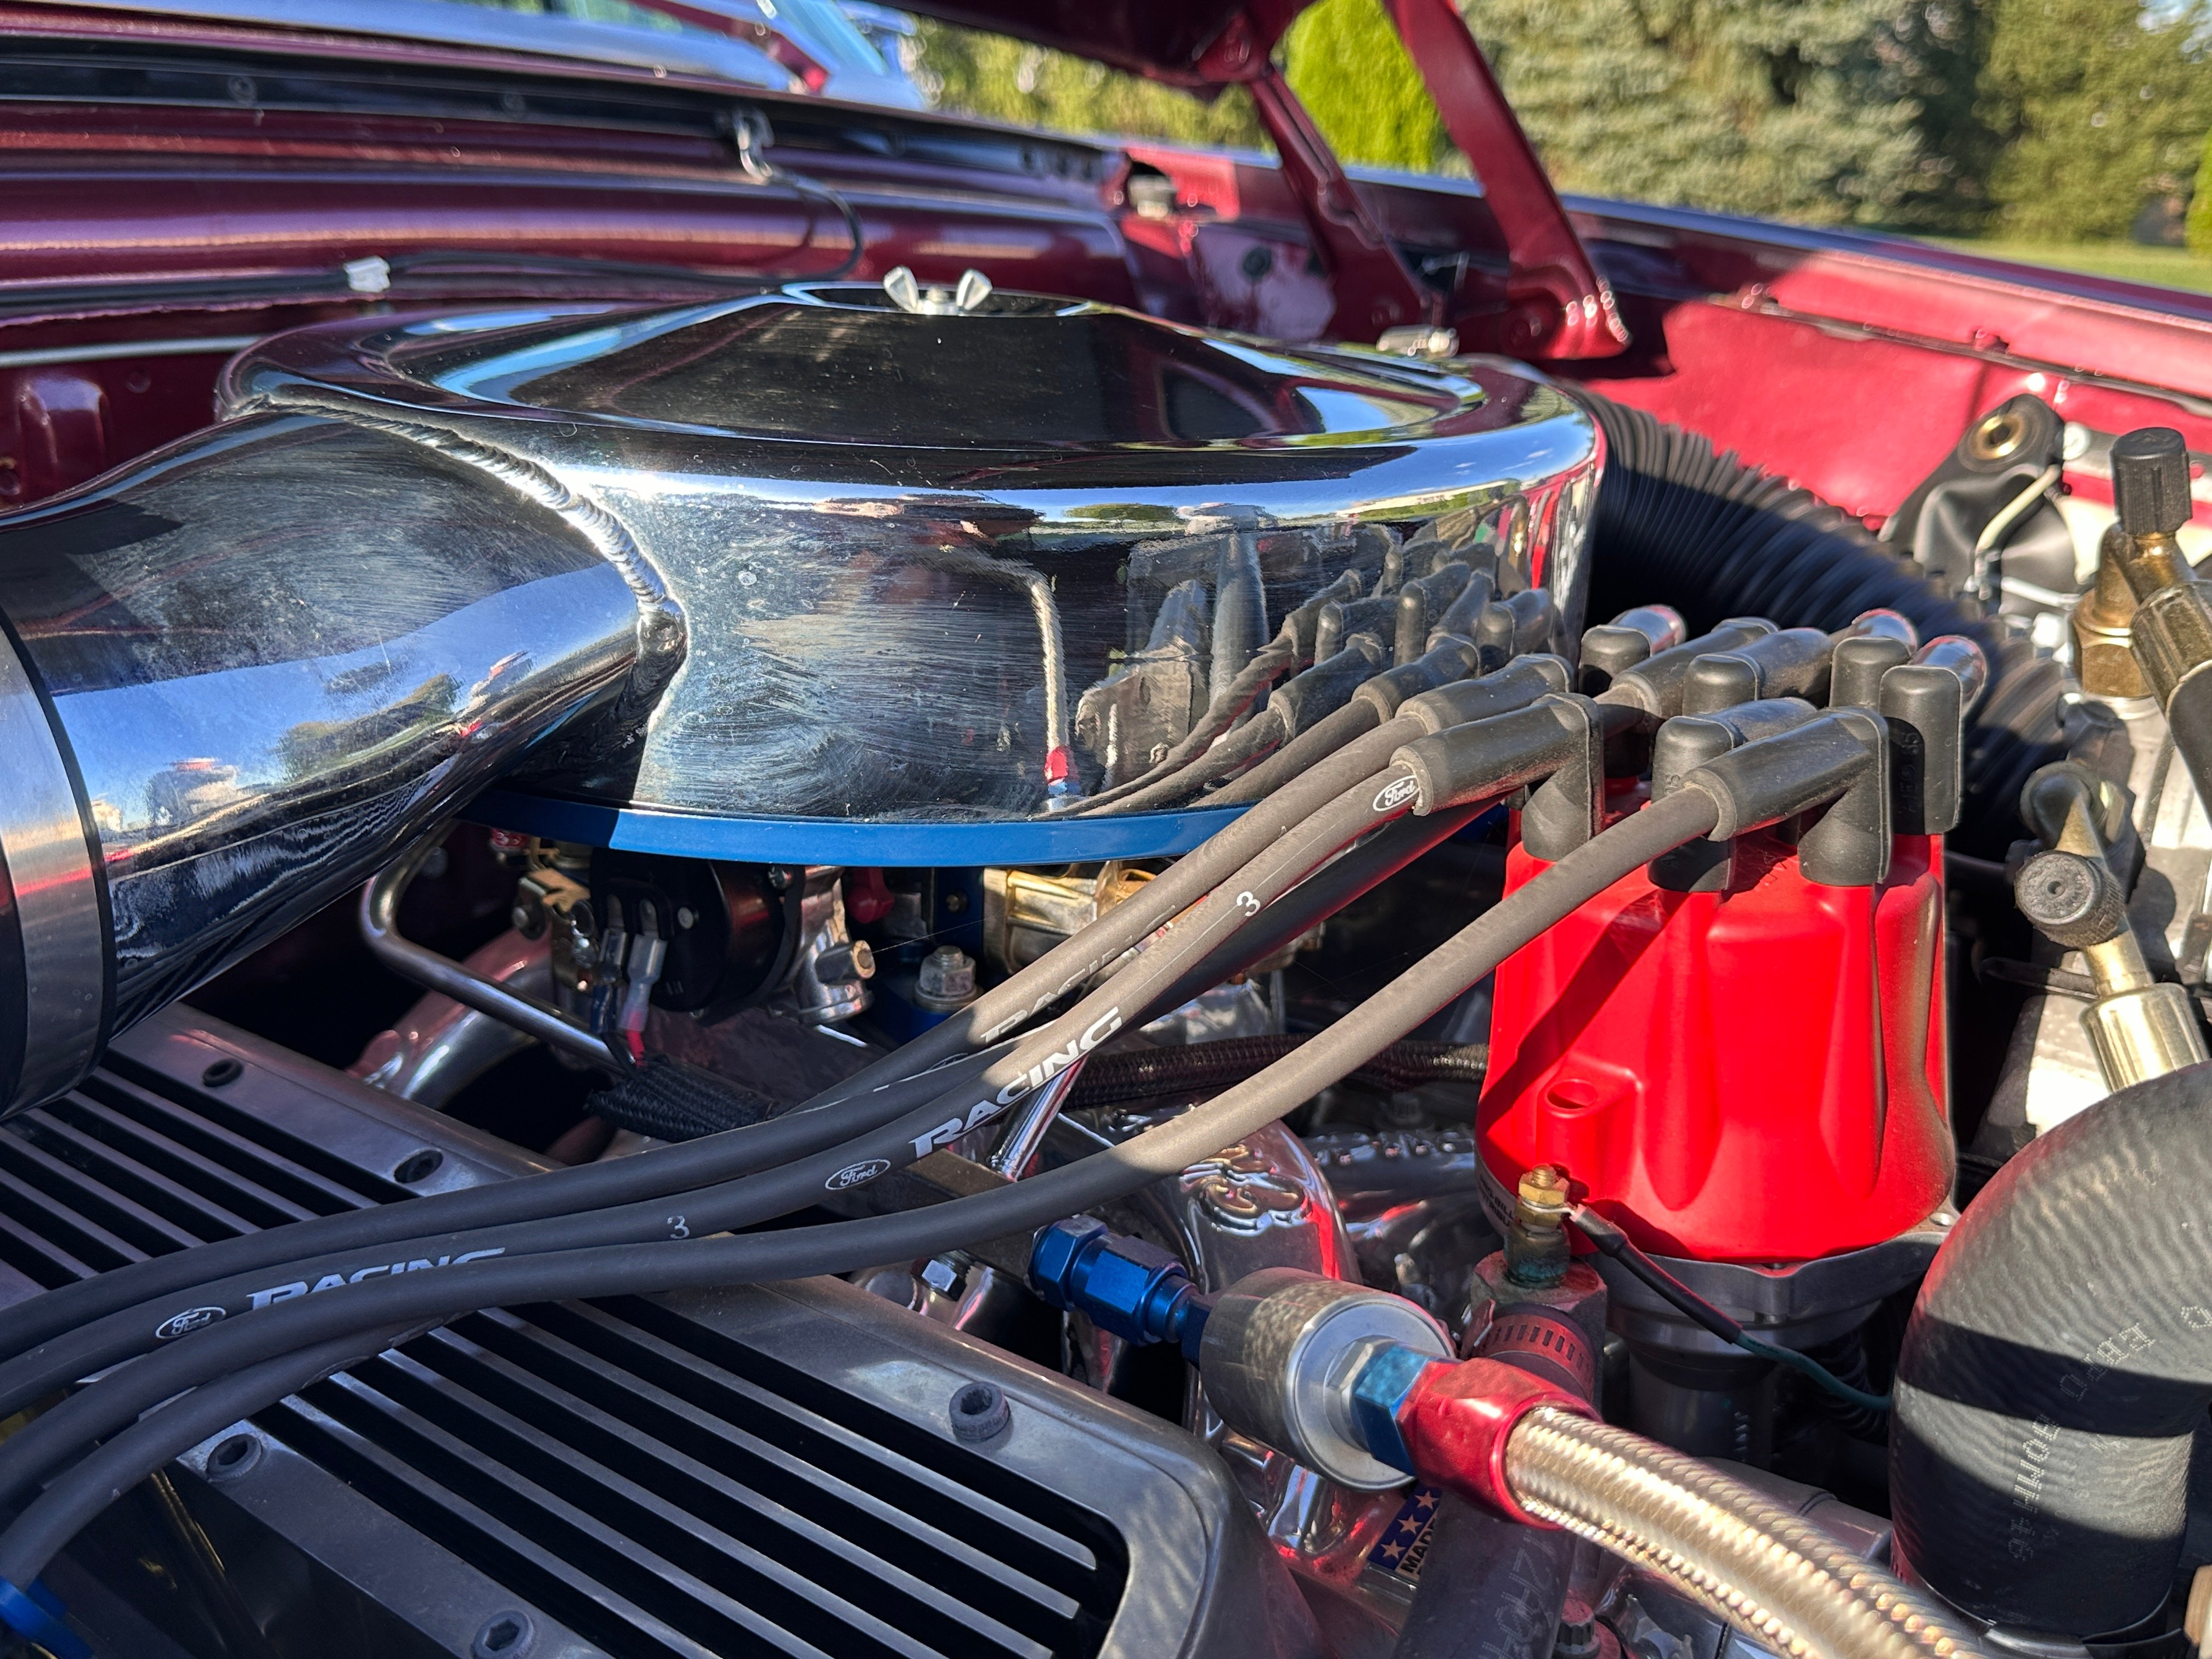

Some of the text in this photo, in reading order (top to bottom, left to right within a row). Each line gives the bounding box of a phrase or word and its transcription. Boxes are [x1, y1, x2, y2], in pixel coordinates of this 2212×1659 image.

[1237, 891, 1260, 917] 3
[909, 1006, 1122, 1159] RACING
[667, 1215, 690, 1239] 3
[1400, 1518, 1437, 1574] MAD
